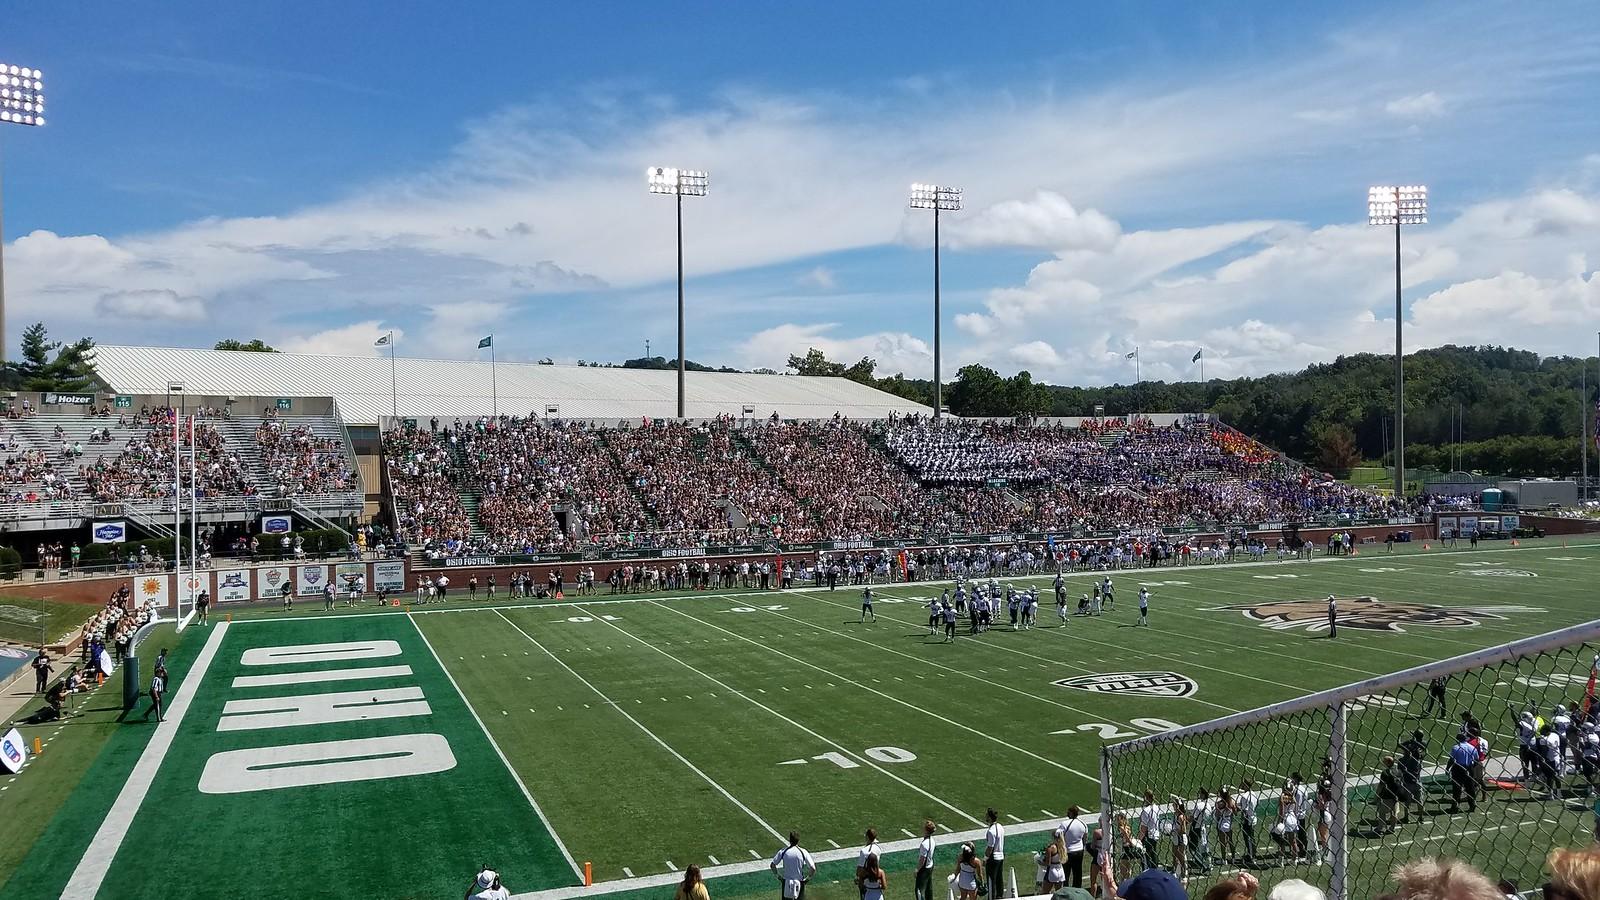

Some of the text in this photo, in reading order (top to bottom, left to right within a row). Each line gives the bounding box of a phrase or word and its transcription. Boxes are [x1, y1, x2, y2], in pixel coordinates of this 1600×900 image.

[58, 395, 90, 403] Holzer
[661, 548, 707, 557] OHIO FOOTBALL
[446, 556, 496, 567] OHIO FOOTBALL
[1086, 675, 1182, 692] MAC
[198, 639, 458, 794] OHIO
[1076, 717, 1185, 740] 20
[811, 746, 918, 769] 10
